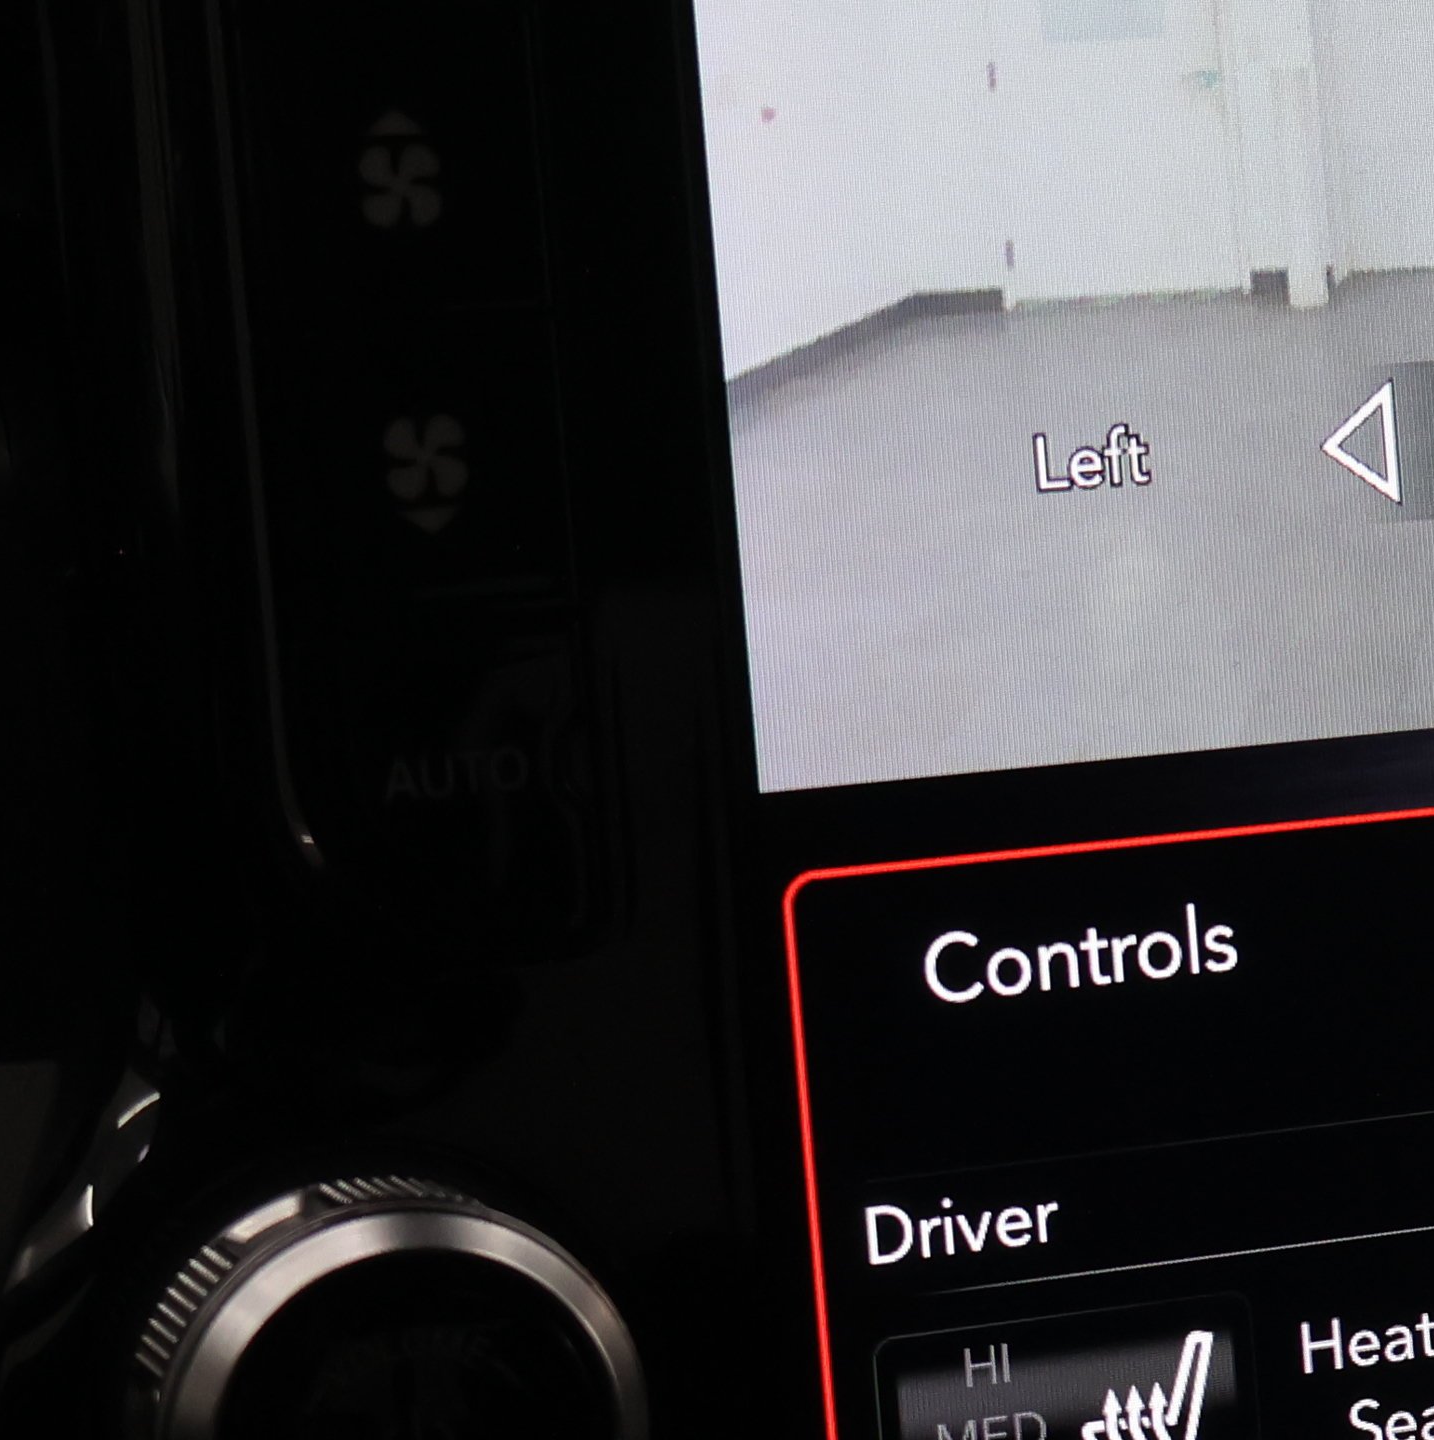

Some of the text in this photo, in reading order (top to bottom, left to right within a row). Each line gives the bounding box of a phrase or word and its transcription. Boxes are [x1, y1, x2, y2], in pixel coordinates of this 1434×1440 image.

[1032, 423, 1152, 493] Left
[384, 744, 529, 804] AUTO
[924, 903, 1238, 1003] Controls
[865, 1198, 1058, 1265] Driver
[965, 1344, 1011, 1388] HI
